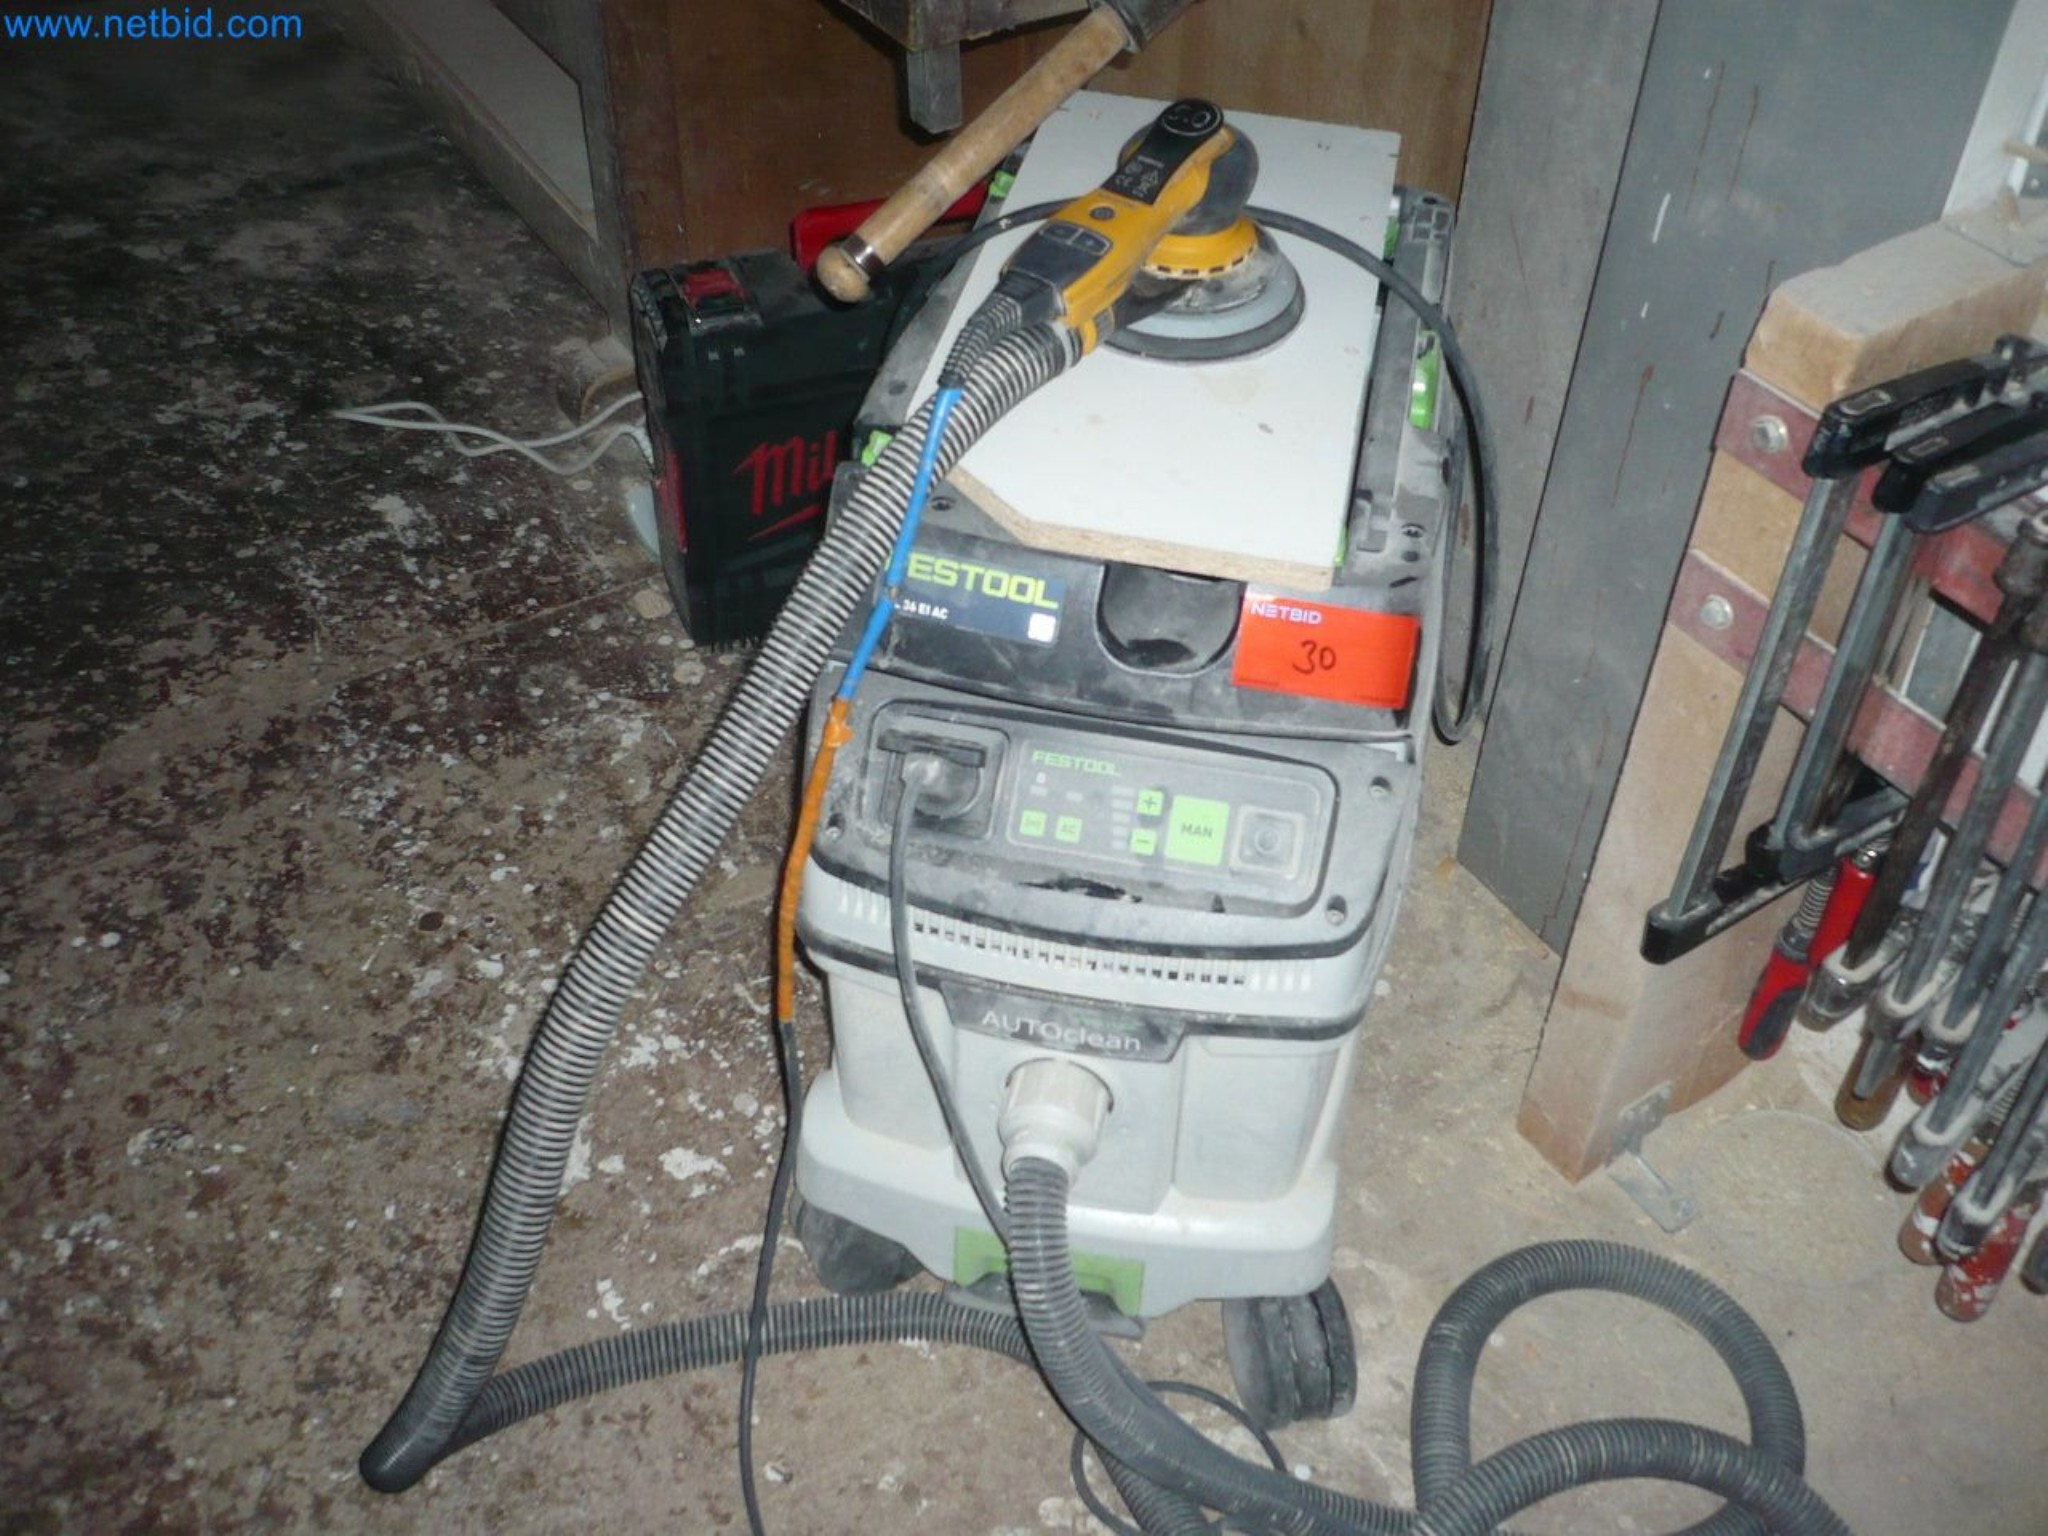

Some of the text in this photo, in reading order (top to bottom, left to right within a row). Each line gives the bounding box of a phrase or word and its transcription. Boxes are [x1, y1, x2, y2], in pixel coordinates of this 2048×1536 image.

[884, 550, 1059, 609] ESTOOL
[931, 606, 949, 620] AC
[1250, 601, 1323, 625] NETBID
[1292, 639, 1337, 675] 30
[1031, 750, 1122, 777] FESTOOL
[1180, 822, 1214, 840] MAN
[981, 1010, 1142, 1052] AUTOclean
